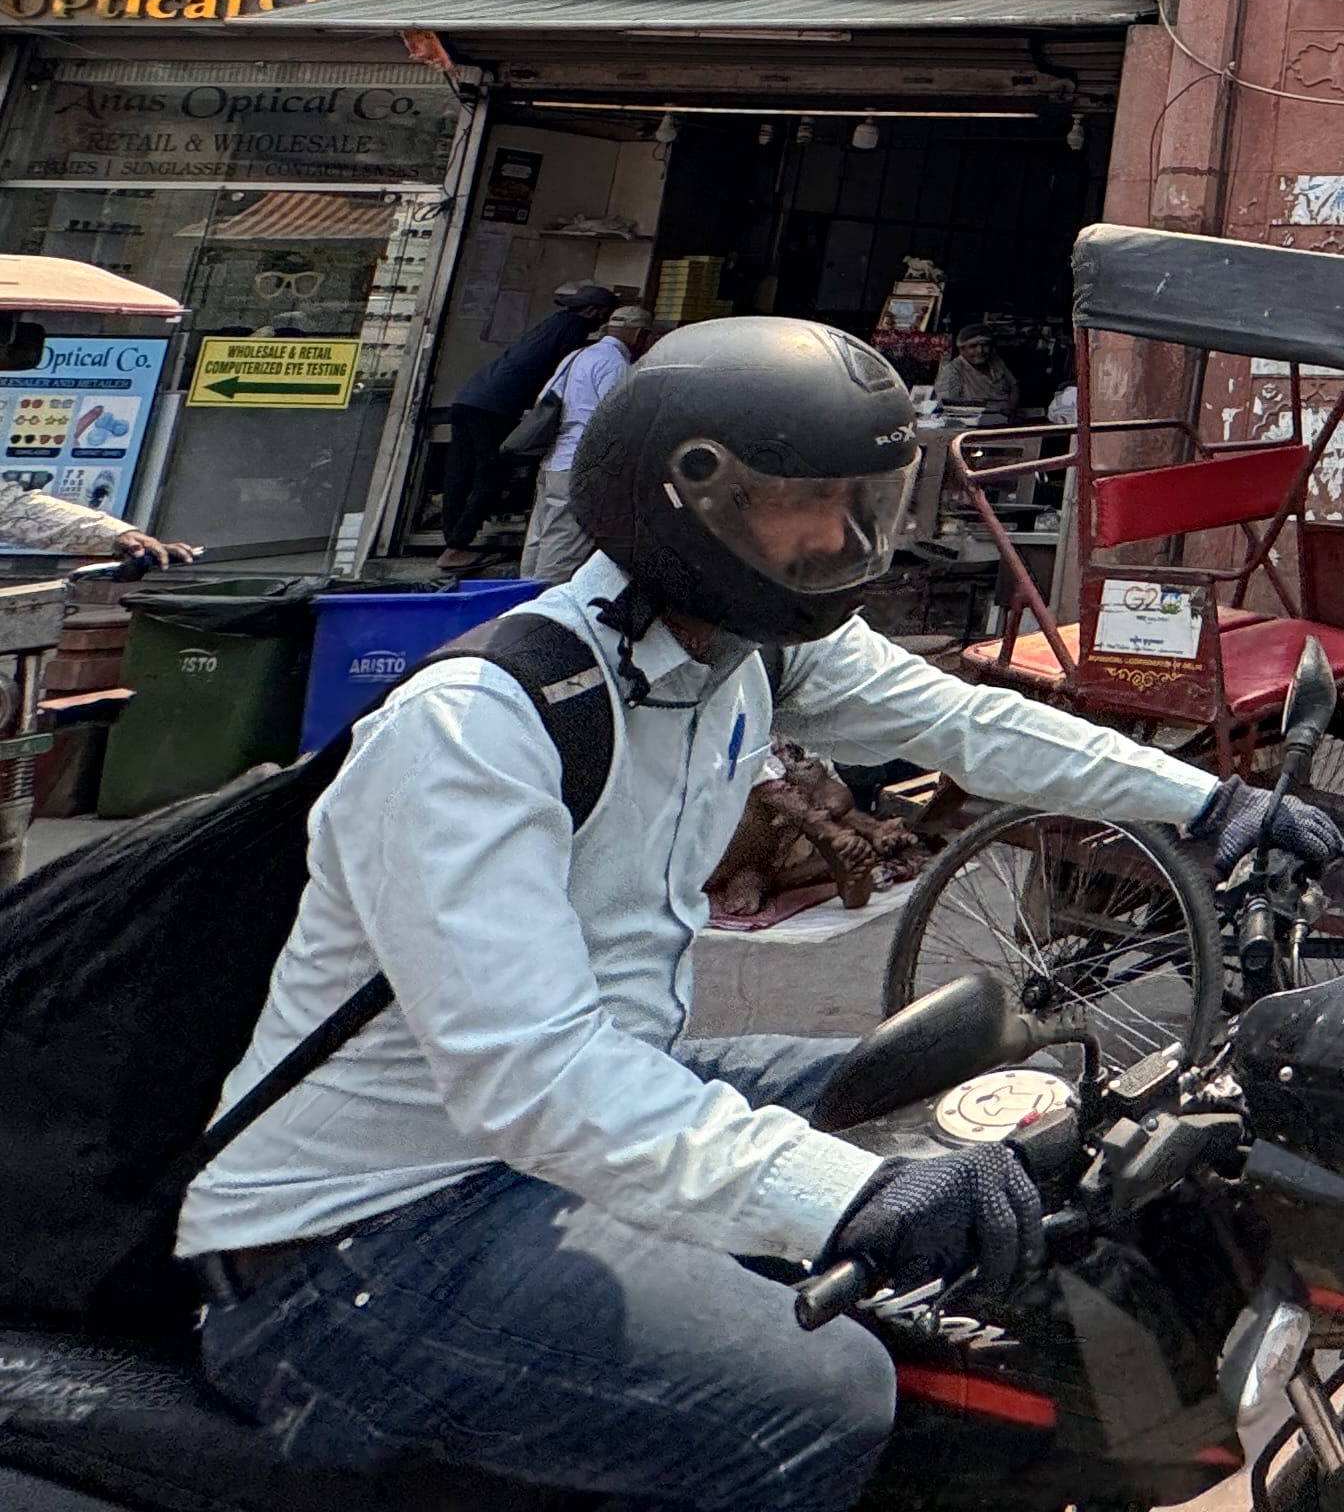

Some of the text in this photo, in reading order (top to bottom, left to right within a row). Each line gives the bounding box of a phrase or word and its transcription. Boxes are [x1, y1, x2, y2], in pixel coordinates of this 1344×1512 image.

[54, 85, 422, 123] Anas Optical Co.
[87, 133, 373, 155] RETAIL & WHOLESALE
[120, 160, 237, 177] SUNGLASSES
[116, 347, 152, 372] Co.
[227, 345, 333, 360] WHOLESALE & RETAIL
[204, 361, 348, 377] COMPUTERIZED EYE TESTING
[349, 657, 405, 674] ARISTO
